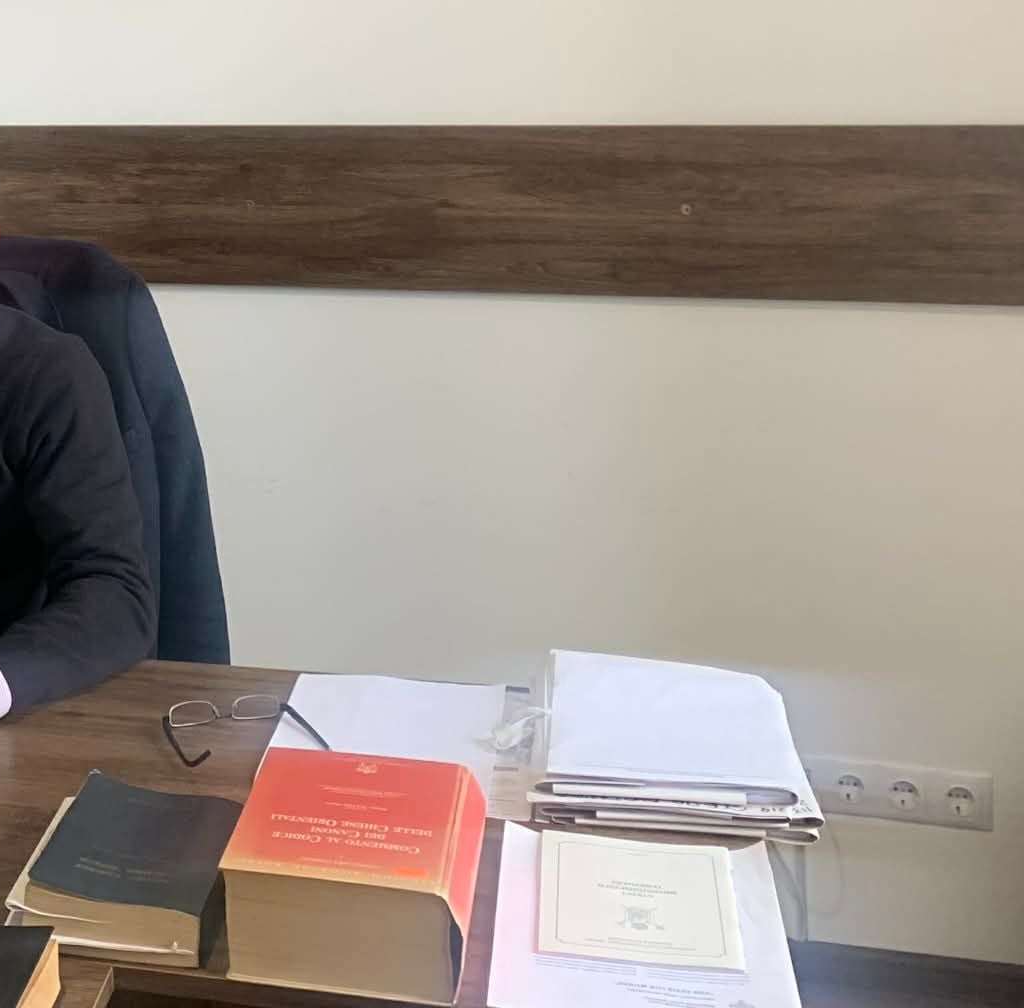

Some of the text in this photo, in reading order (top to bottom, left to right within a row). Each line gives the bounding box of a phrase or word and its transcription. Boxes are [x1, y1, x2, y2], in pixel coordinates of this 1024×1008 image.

[271, 813, 433, 837] DELLE CHIESE ORIENTALI
[310, 825, 387, 840] DEI CANONI
[272, 830, 420, 855] COMMENTO AL CODICE
